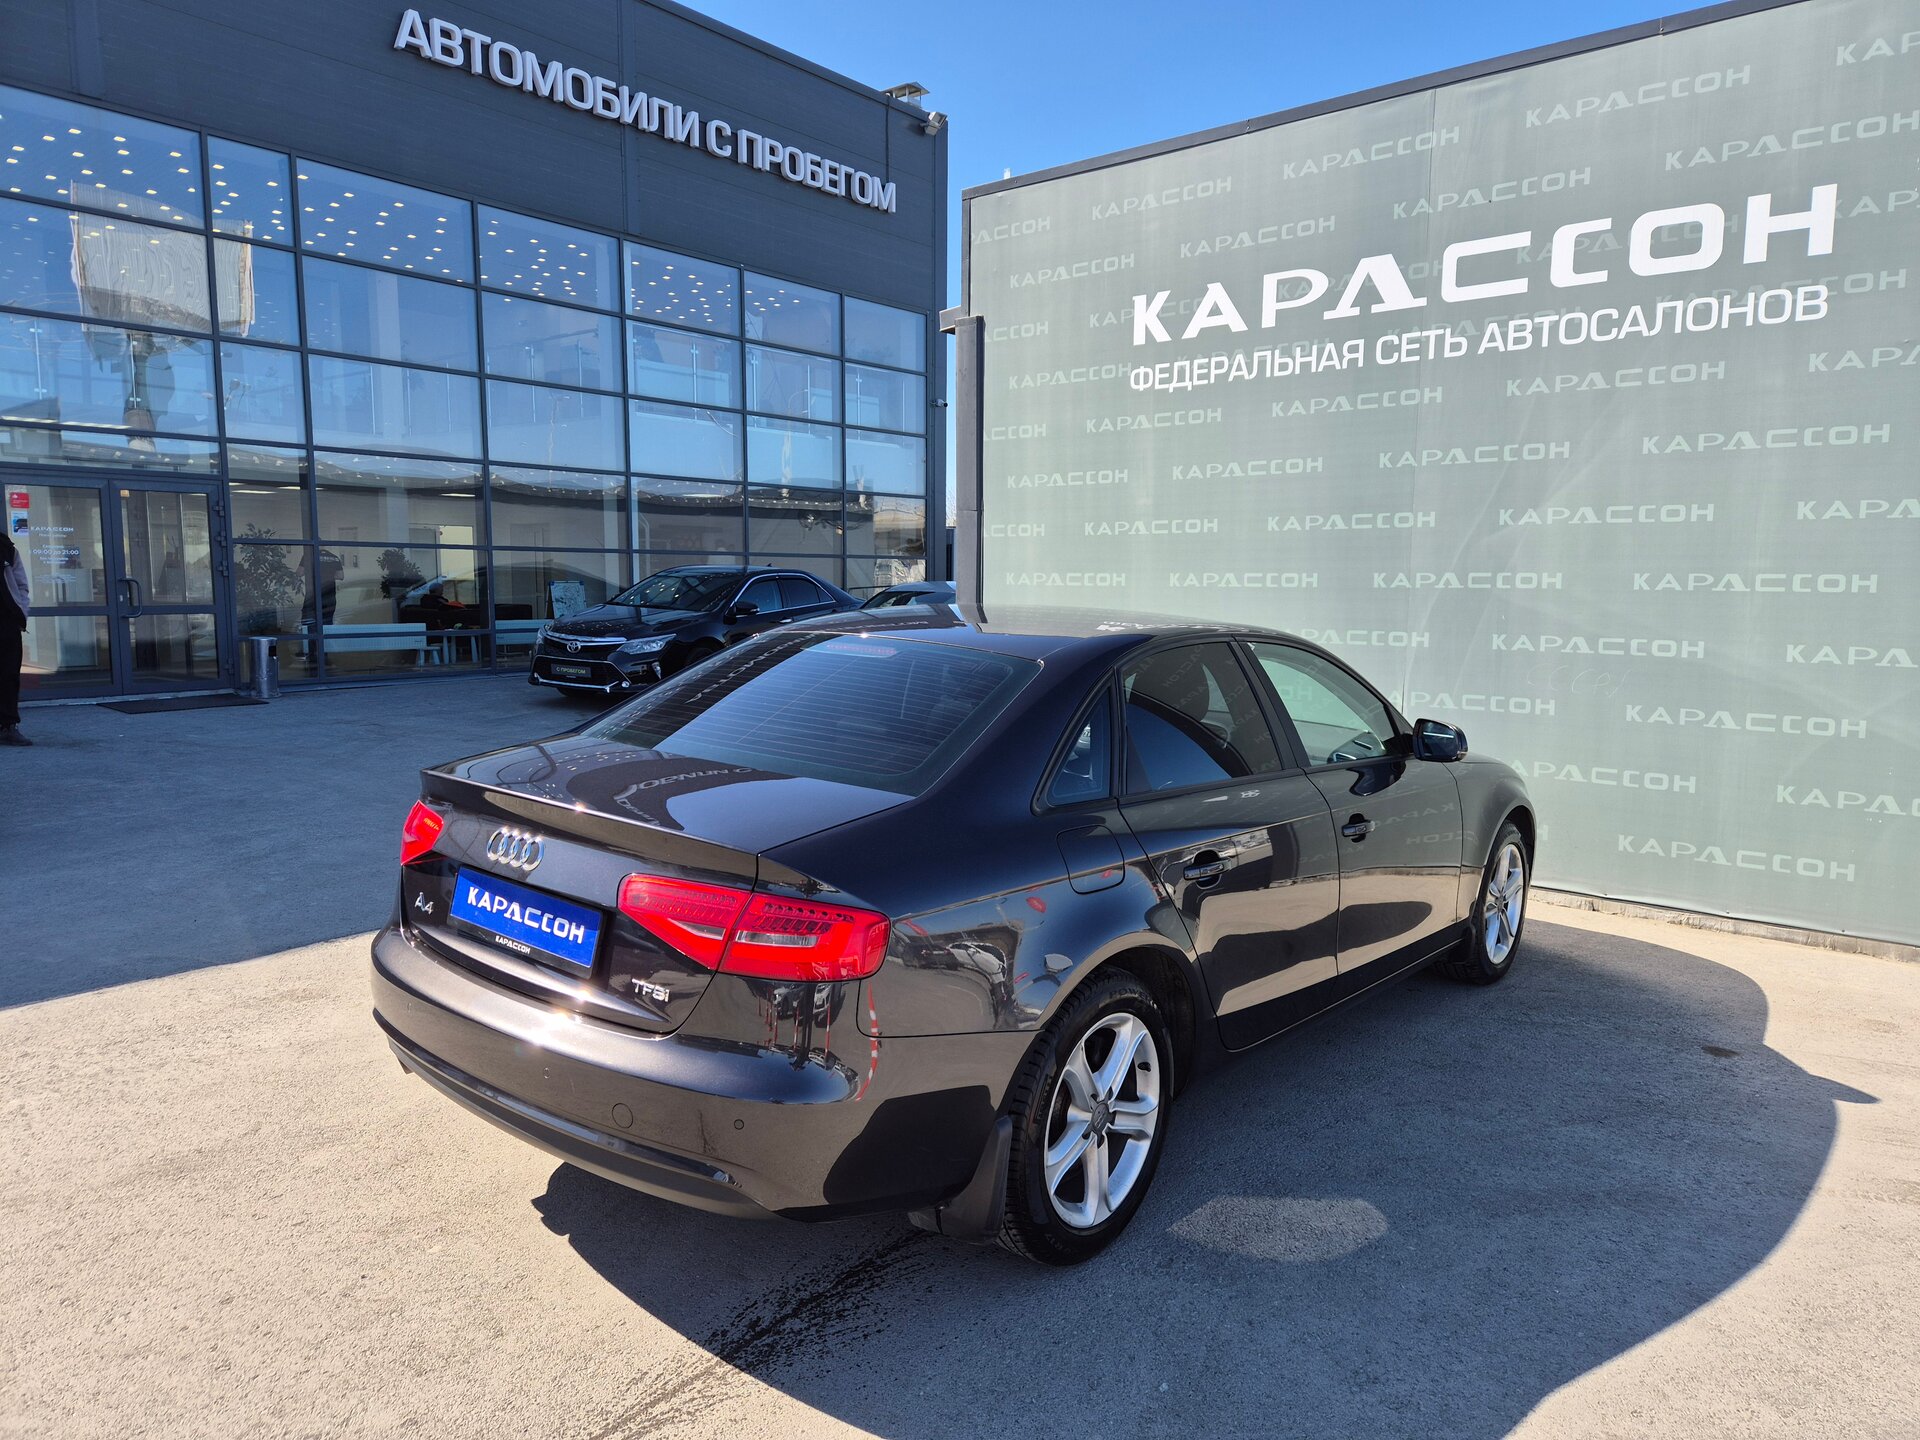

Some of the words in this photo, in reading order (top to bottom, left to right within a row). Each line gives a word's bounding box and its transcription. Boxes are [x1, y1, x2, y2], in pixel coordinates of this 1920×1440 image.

[393, 8, 699, 148] АВТОМОБИЛИ
[706, 119, 732, 158] С
[737, 129, 897, 213] ПРОБЕГОМ
[1526, 64, 1751, 129] КАРЛССОН
[1283, 125, 1460, 181] КАРЛССОН
[1092, 176, 1232, 220] КАРЛССОН
[1393, 167, 1591, 220] КАРЛССОН
[971, 216, 1051, 245] ЛССОН
[1180, 215, 1335, 259] КАРЛССОН
[1010, 253, 1135, 289] КАРЛССОН
[1132, 184, 1838, 346] КАРЛССОН
[984, 321, 1049, 343] ССОН
[1130, 339, 1363, 392] ФЕДЕРАЛЬНАЯ
[1375, 327, 1468, 365] СЕТЬ
[1477, 285, 1829, 355] АВТОСАЛОНОВ
[1506, 360, 1726, 398] КАРЛССОН
[1271, 386, 1443, 418] КАРЛССОН
[984, 423, 1047, 441] ССОН
[1086, 407, 1222, 434] КАРЛССОН
[1642, 423, 1891, 456] КАРЛССОН
[1172, 456, 1323, 481] КАРЛССОН
[1379, 441, 1570, 470] КАРЛССОН
[1007, 468, 1128, 490] КАРЛССОН
[1084, 518, 1219, 536] КАРЛССОН
[1267, 511, 1436, 532] КАРЛССОН
[1499, 503, 1715, 526] КАРЛССОН
[984, 523, 1046, 538] ССОН
[1005, 572, 1126, 588] КАРЛССОН
[1169, 572, 1319, 589] КАРЛССОН
[1372, 572, 1563, 590] КАРЛССОН
[1633, 572, 1878, 594] КАРЛССОН
[1491, 633, 1705, 659] КАРЛССОН
[1626, 704, 1868, 739] КАРЛССОН
[1618, 834, 1856, 883] КАРЛССОН
[414, 892, 434, 915] A4
[467, 886, 585, 944] КАРЛССОН
